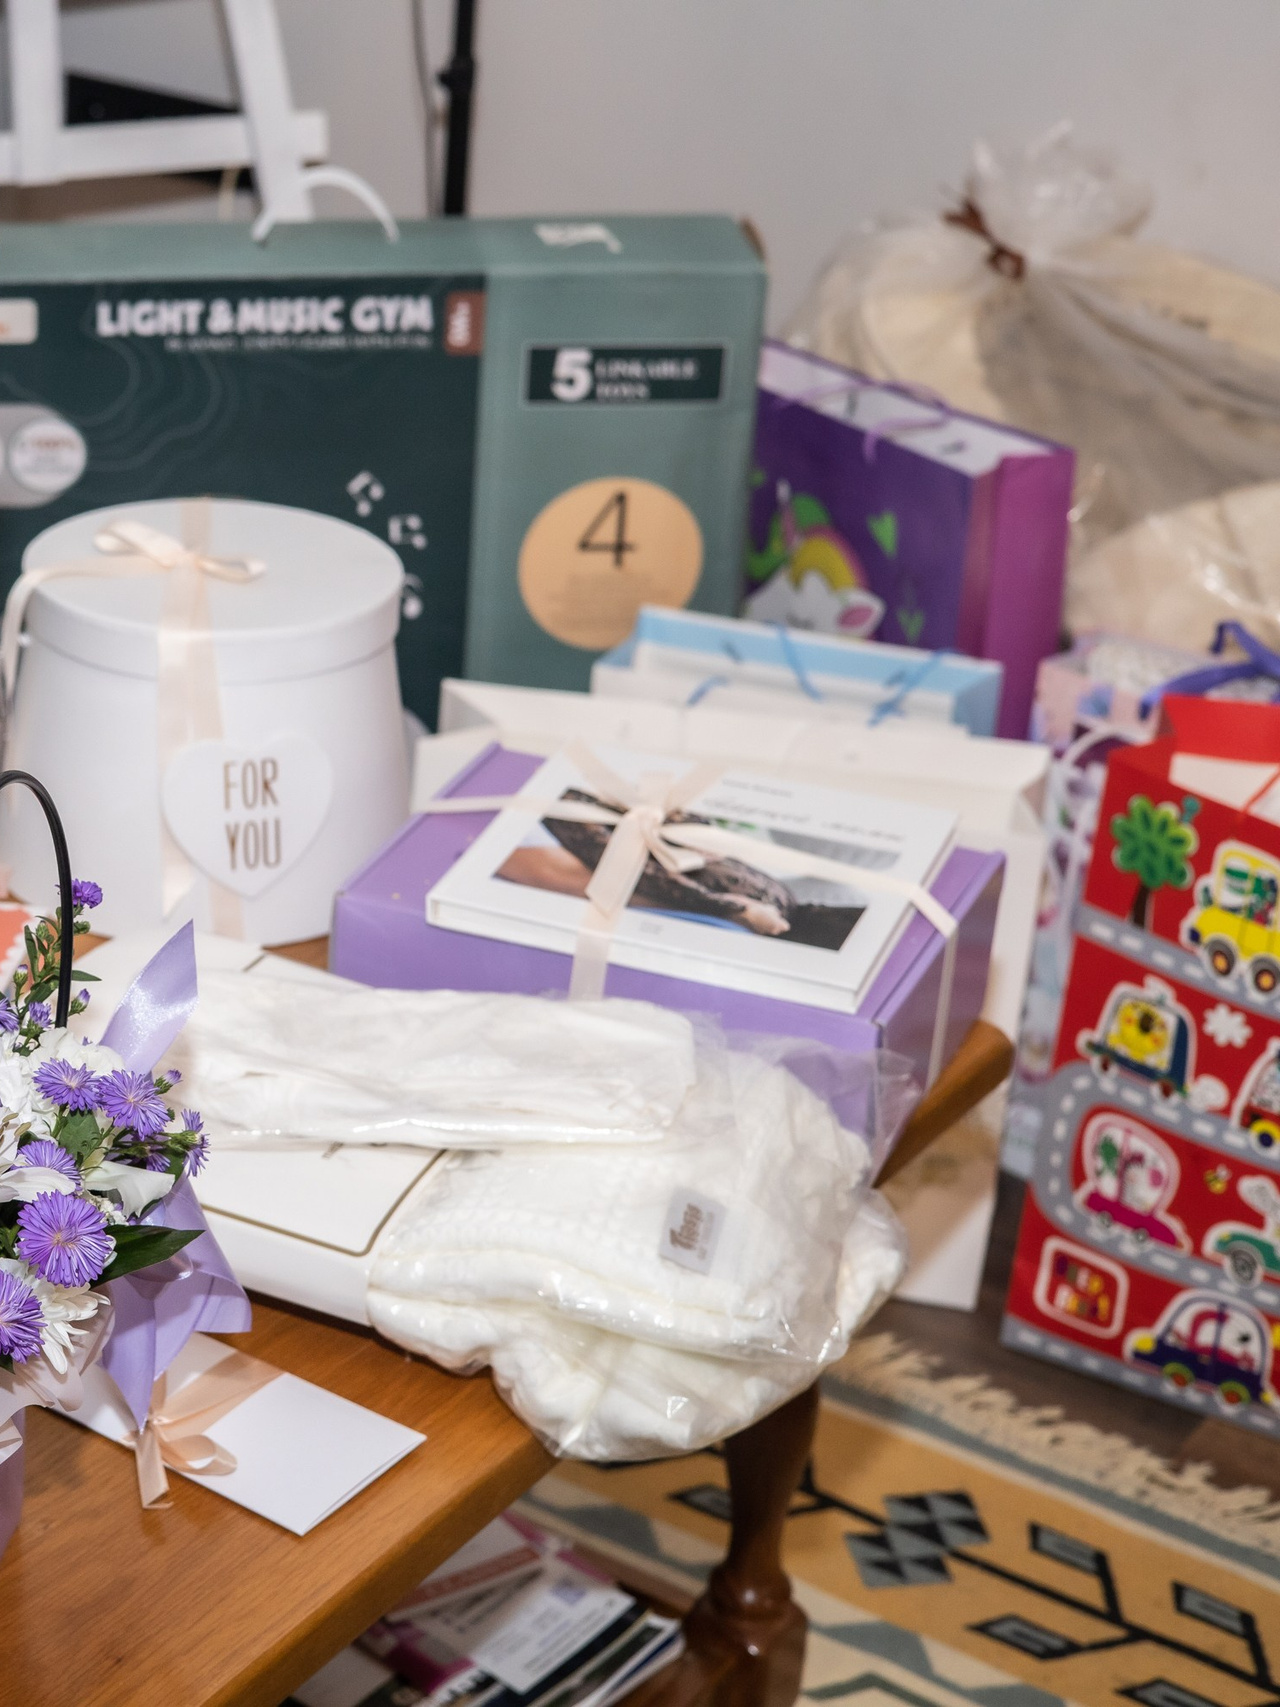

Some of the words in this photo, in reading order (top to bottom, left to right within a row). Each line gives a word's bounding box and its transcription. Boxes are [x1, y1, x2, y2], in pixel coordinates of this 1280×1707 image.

[96, 299, 204, 336] LIGHT
[350, 295, 434, 333] GYM
[551, 348, 593, 401] 5
[577, 491, 635, 568] 4
[223, 757, 278, 811] FOR
[225, 818, 281, 870] YOU
